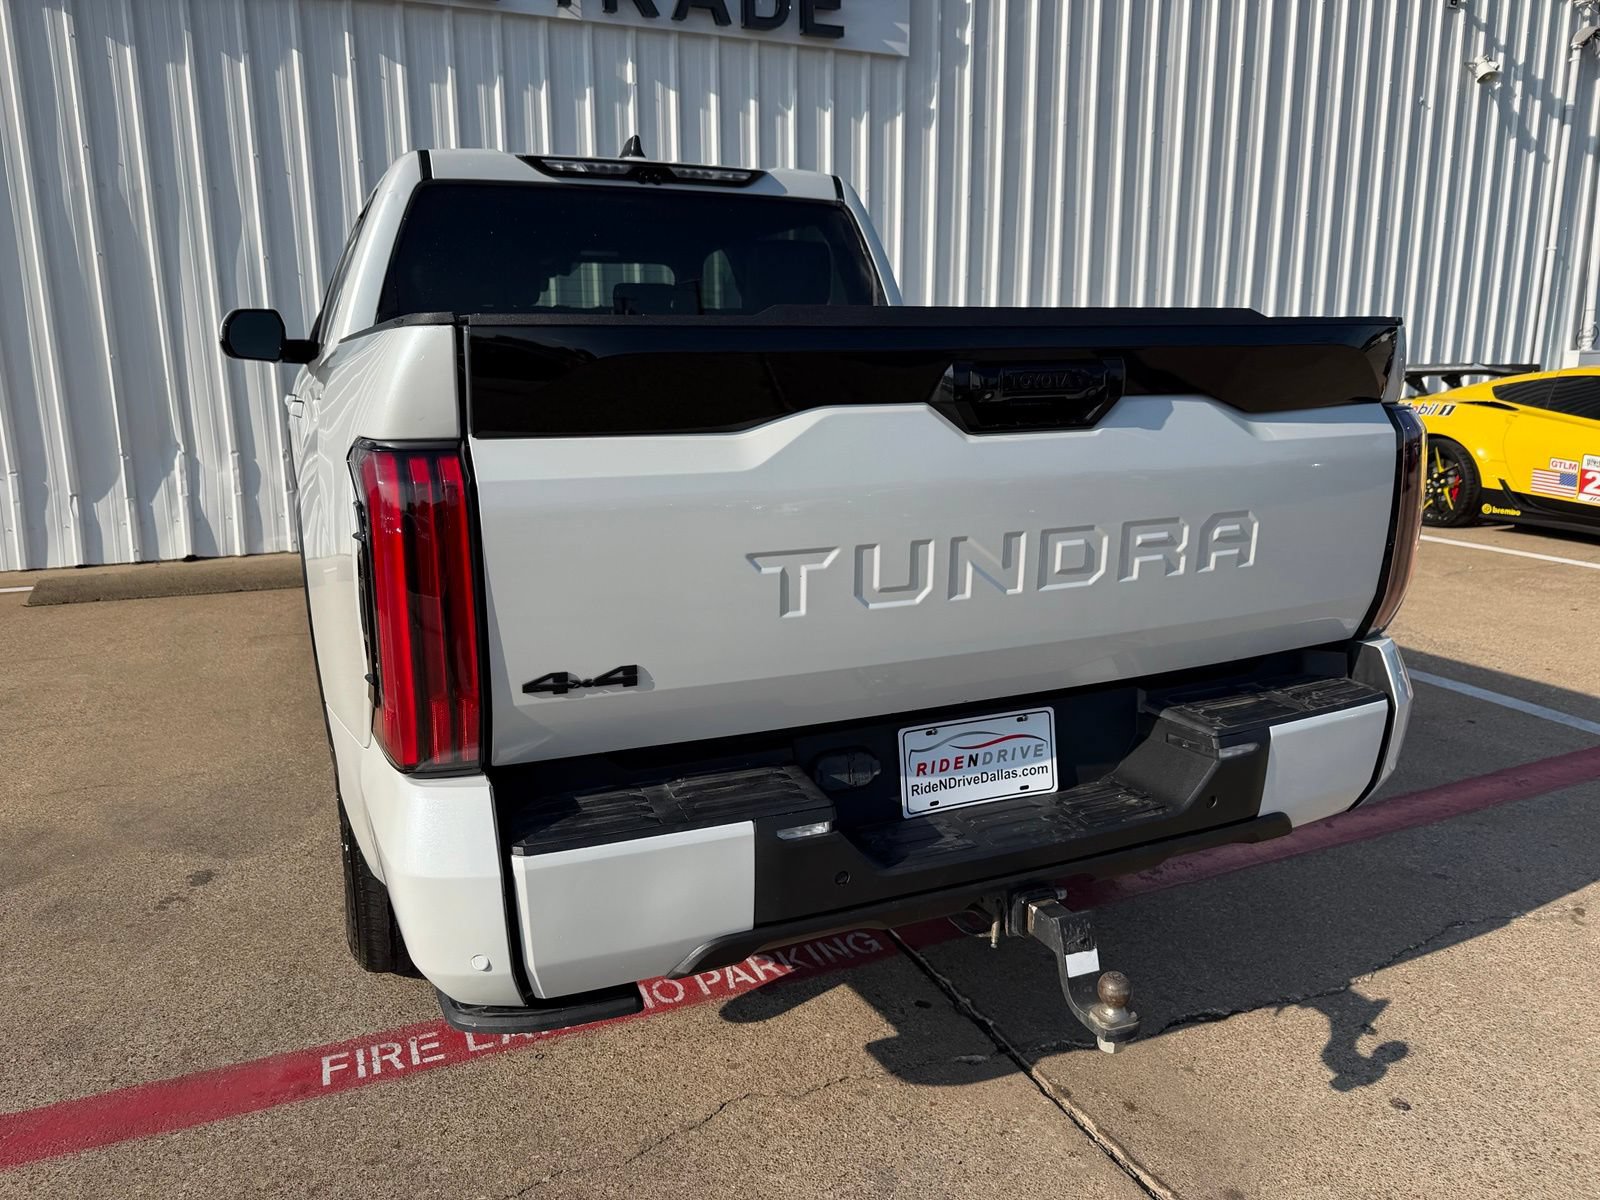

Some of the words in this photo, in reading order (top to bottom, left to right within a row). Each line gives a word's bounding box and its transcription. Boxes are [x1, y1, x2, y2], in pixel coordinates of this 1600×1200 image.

[1009, 373, 1073, 389] TOYOTA
[1551, 460, 1578, 471] GTLM
[1492, 506, 1521, 517] brembo
[745, 509, 1260, 619] TUNDRA
[521, 664, 638, 695] 4x4
[915, 743, 1045, 777] RIDENDRIVE
[911, 764, 1049, 797] RideNDriveDallas.com
[321, 1031, 446, 1087] FIRE
[694, 932, 883, 996] PARKING
